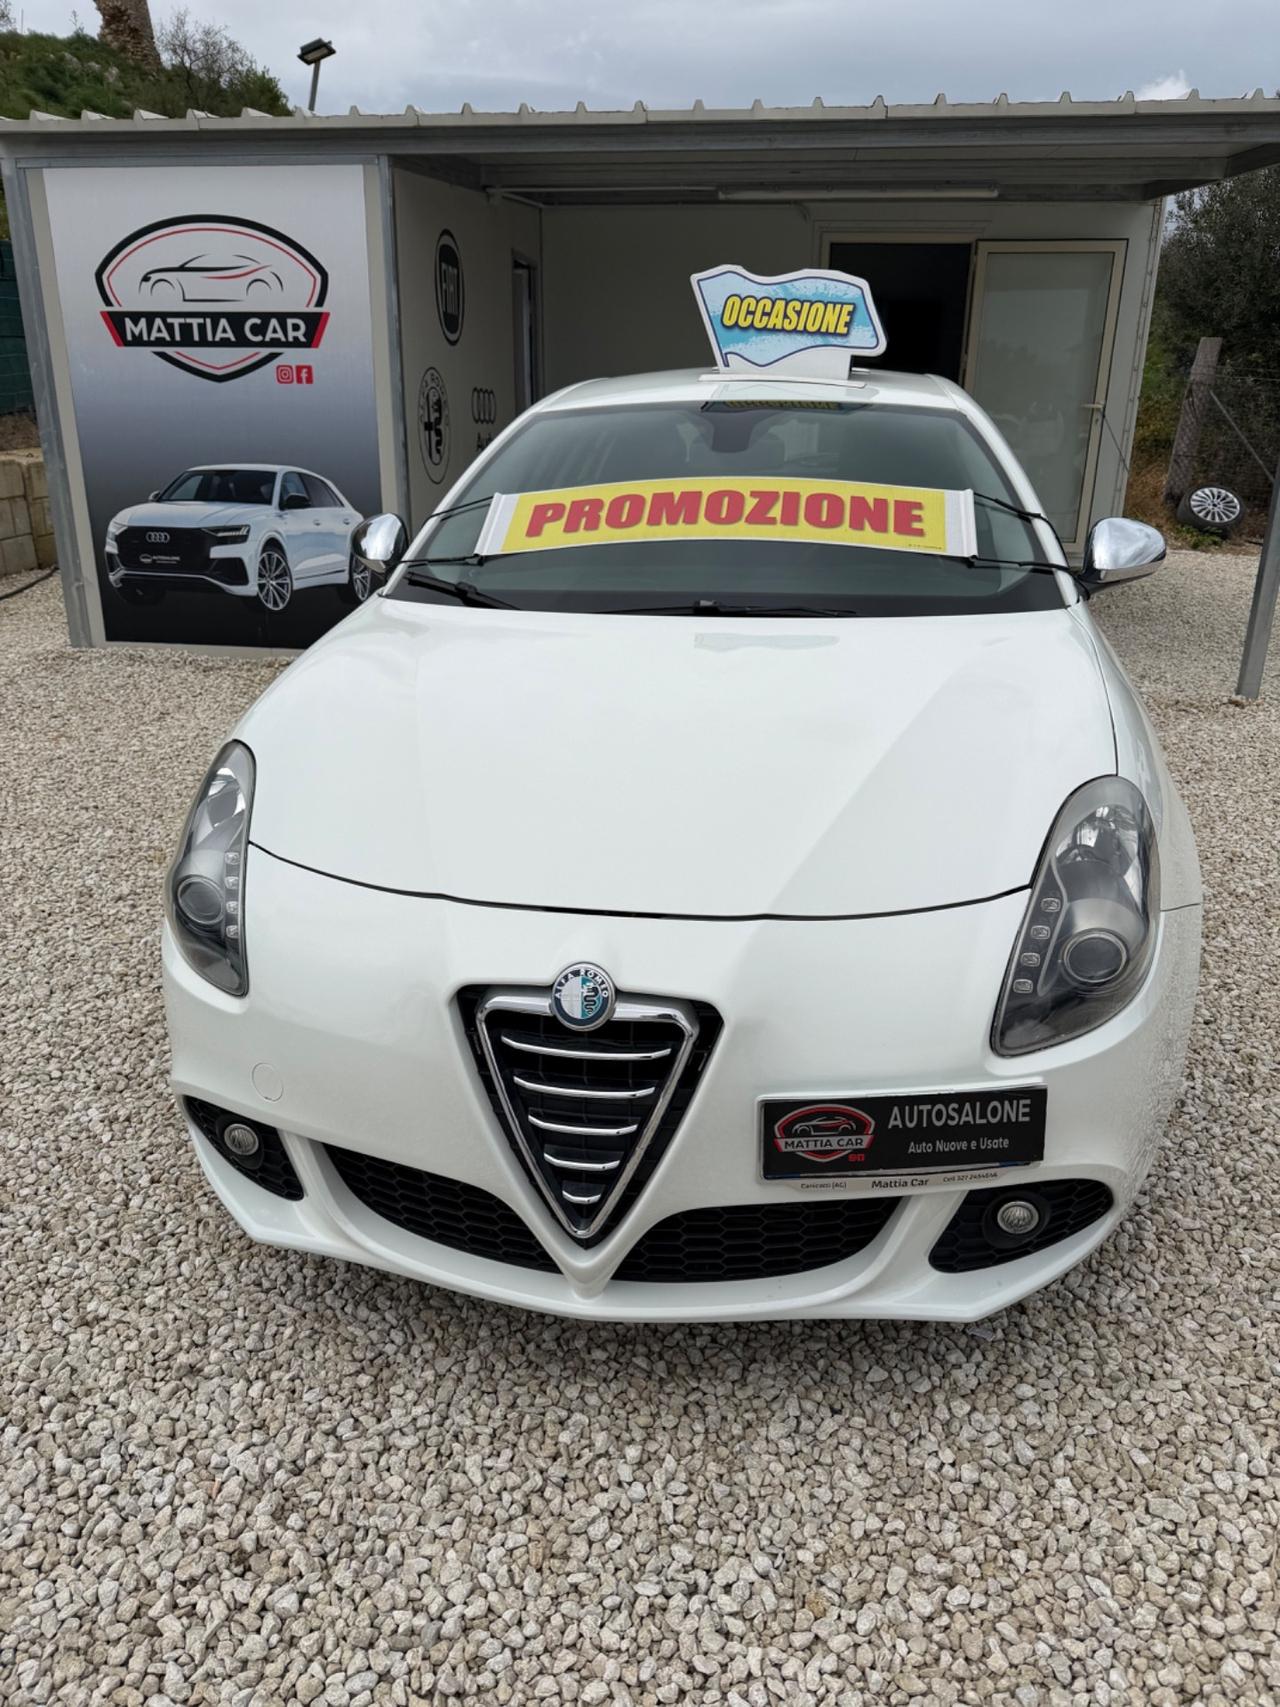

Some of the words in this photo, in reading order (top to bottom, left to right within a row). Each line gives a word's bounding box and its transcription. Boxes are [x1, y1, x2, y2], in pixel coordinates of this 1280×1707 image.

[721, 294, 856, 335] OCCASIONE
[124, 317, 237, 342] MATTIA
[244, 317, 307, 342] CAR
[525, 489, 927, 537] PROMOZIONE
[555, 972, 575, 999] ALFA
[579, 968, 609, 998] ROMEO
[888, 1099, 1031, 1129] AUTOSALONE
[784, 1138, 833, 1150] MATTIA
[837, 1138, 864, 1148] CAR
[908, 1141, 933, 1154] Auto
[935, 1138, 968, 1152] Nuove
[970, 1140, 977, 1150] e
[980, 1136, 1009, 1150] Usate
[871, 1179, 908, 1189] Mattia
[910, 1178, 930, 1187] Car
